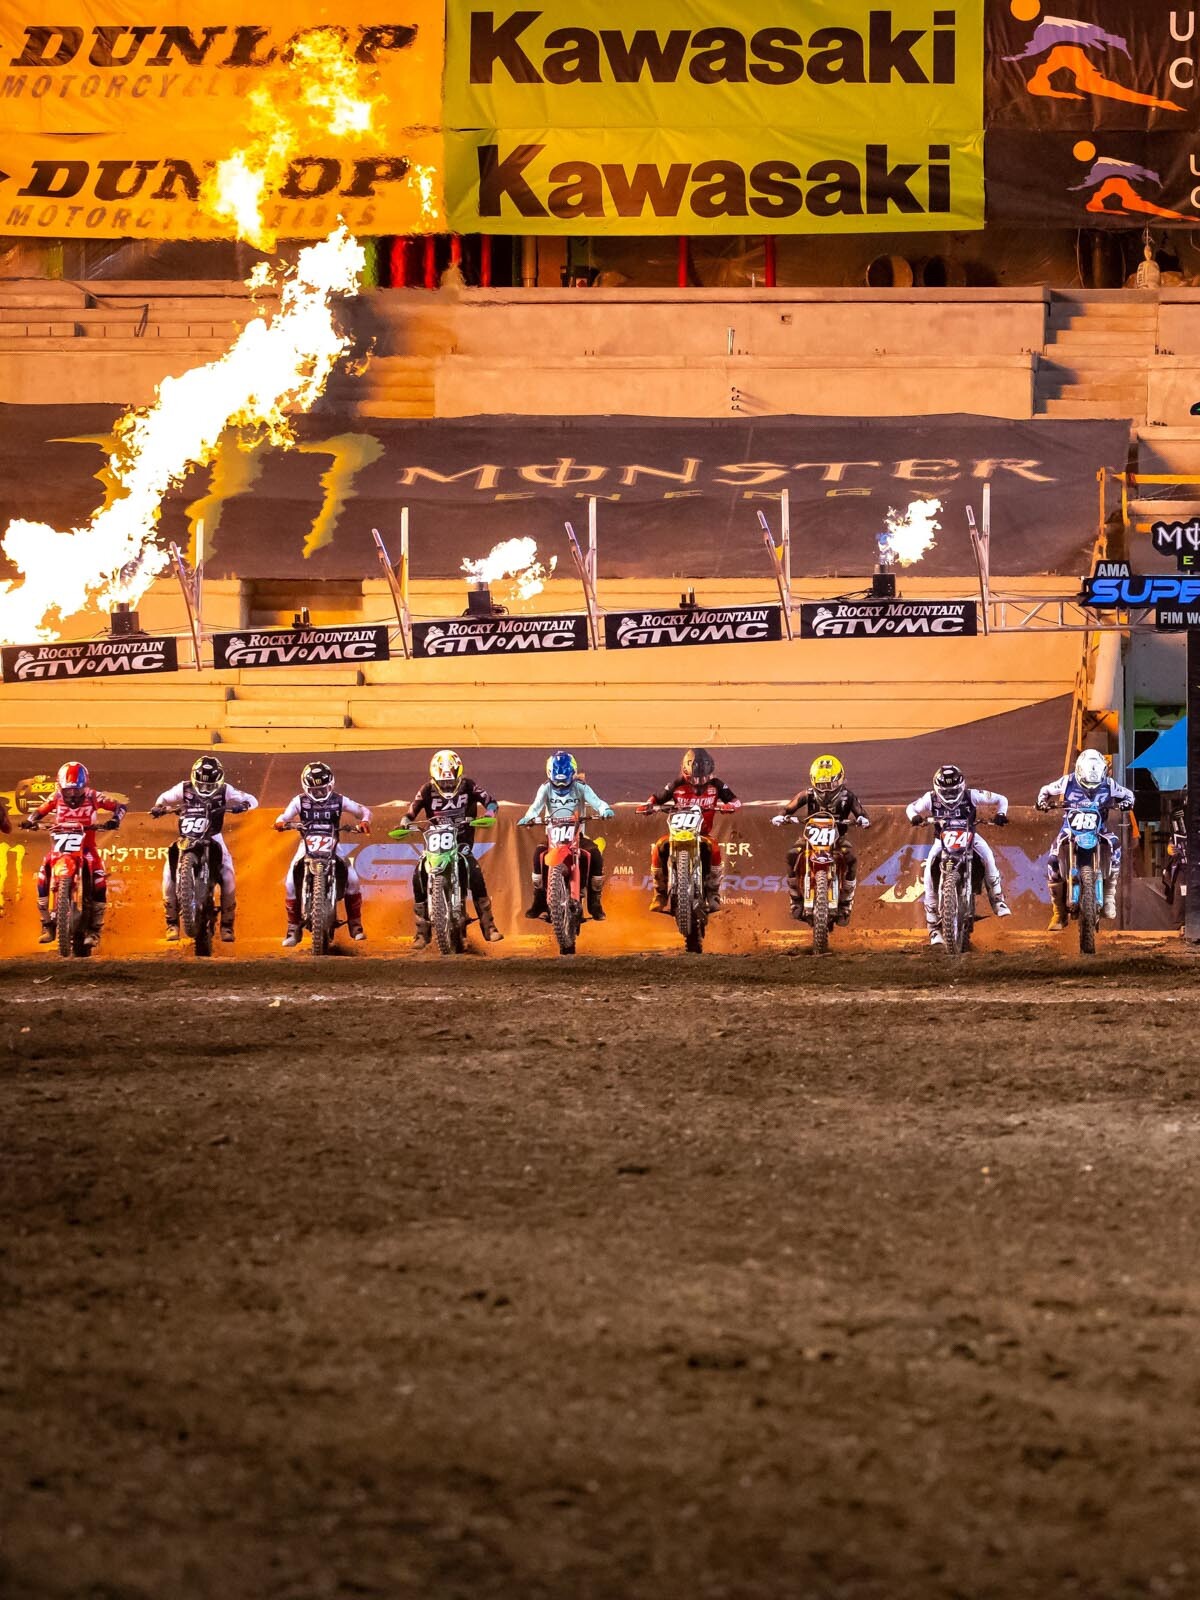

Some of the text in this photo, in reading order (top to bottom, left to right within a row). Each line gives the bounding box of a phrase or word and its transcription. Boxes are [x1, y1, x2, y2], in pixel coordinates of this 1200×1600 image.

[470, 10, 956, 86] Kawasaki
[476, 144, 950, 219] Kawasaki
[397, 458, 1059, 490] MONSTER
[1097, 564, 1130, 577] AMA
[640, 610, 769, 627] ROCKY MOUNTAIN
[836, 604, 965, 617] ROCKY MOUNTAIN
[1160, 612, 1184, 625] FIM
[447, 620, 576, 636] ROCKY MOUNTAIN
[249, 630, 376, 647] ROCKY MOUNTAIN
[37, 641, 165, 660] ROCKY MOUNTAIN
[432, 793, 469, 810] FXR
[181, 817, 209, 834] 59
[670, 813, 698, 829] 90
[1071, 813, 1097, 830] 48
[429, 832, 454, 851] 88
[551, 825, 575, 842] 914
[808, 828, 836, 846] 241
[944, 830, 969, 848] 64
[53, 833, 83, 853] 72
[308, 836, 334, 852] 32
[613, 865, 634, 875] AMA
